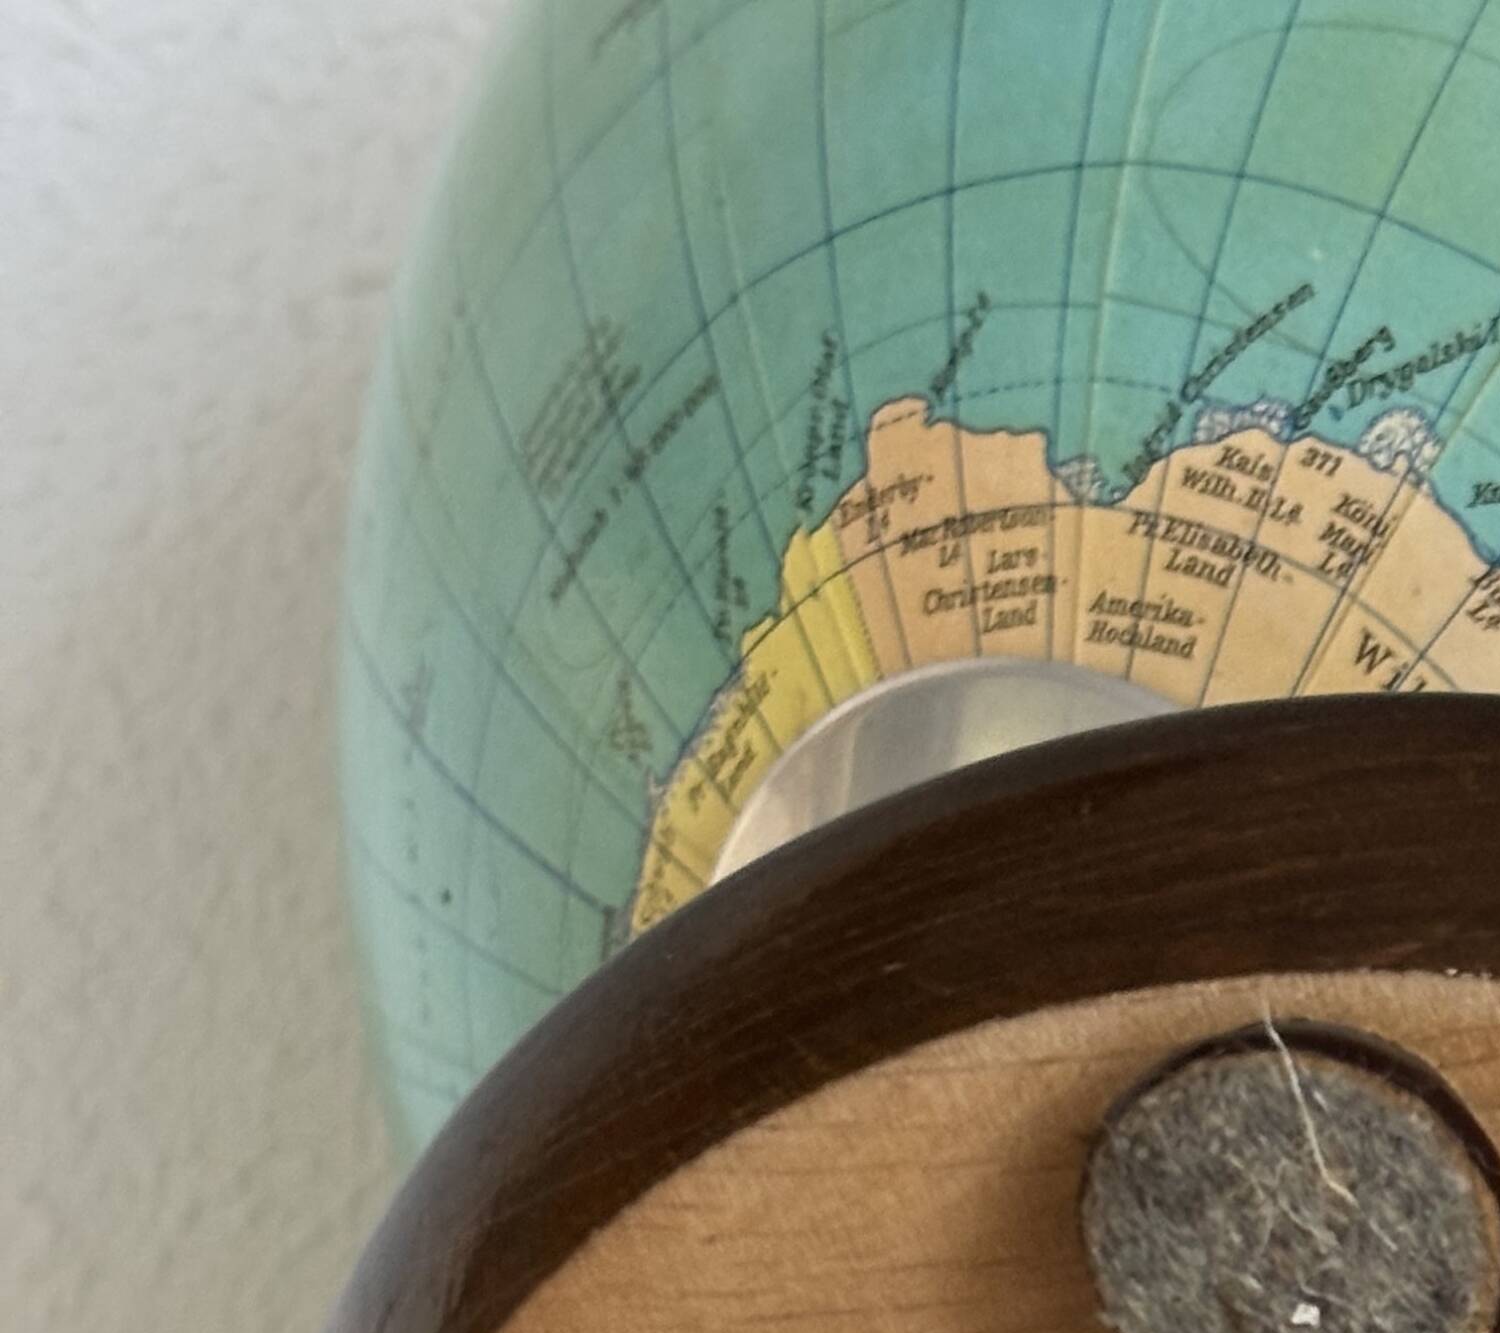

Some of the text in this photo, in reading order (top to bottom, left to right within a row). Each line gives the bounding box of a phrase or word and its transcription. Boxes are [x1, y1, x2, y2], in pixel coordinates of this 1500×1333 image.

[1163, 547, 1237, 589] Land
[980, 598, 1038, 635] Land
[1082, 618, 1199, 661] Hochland
